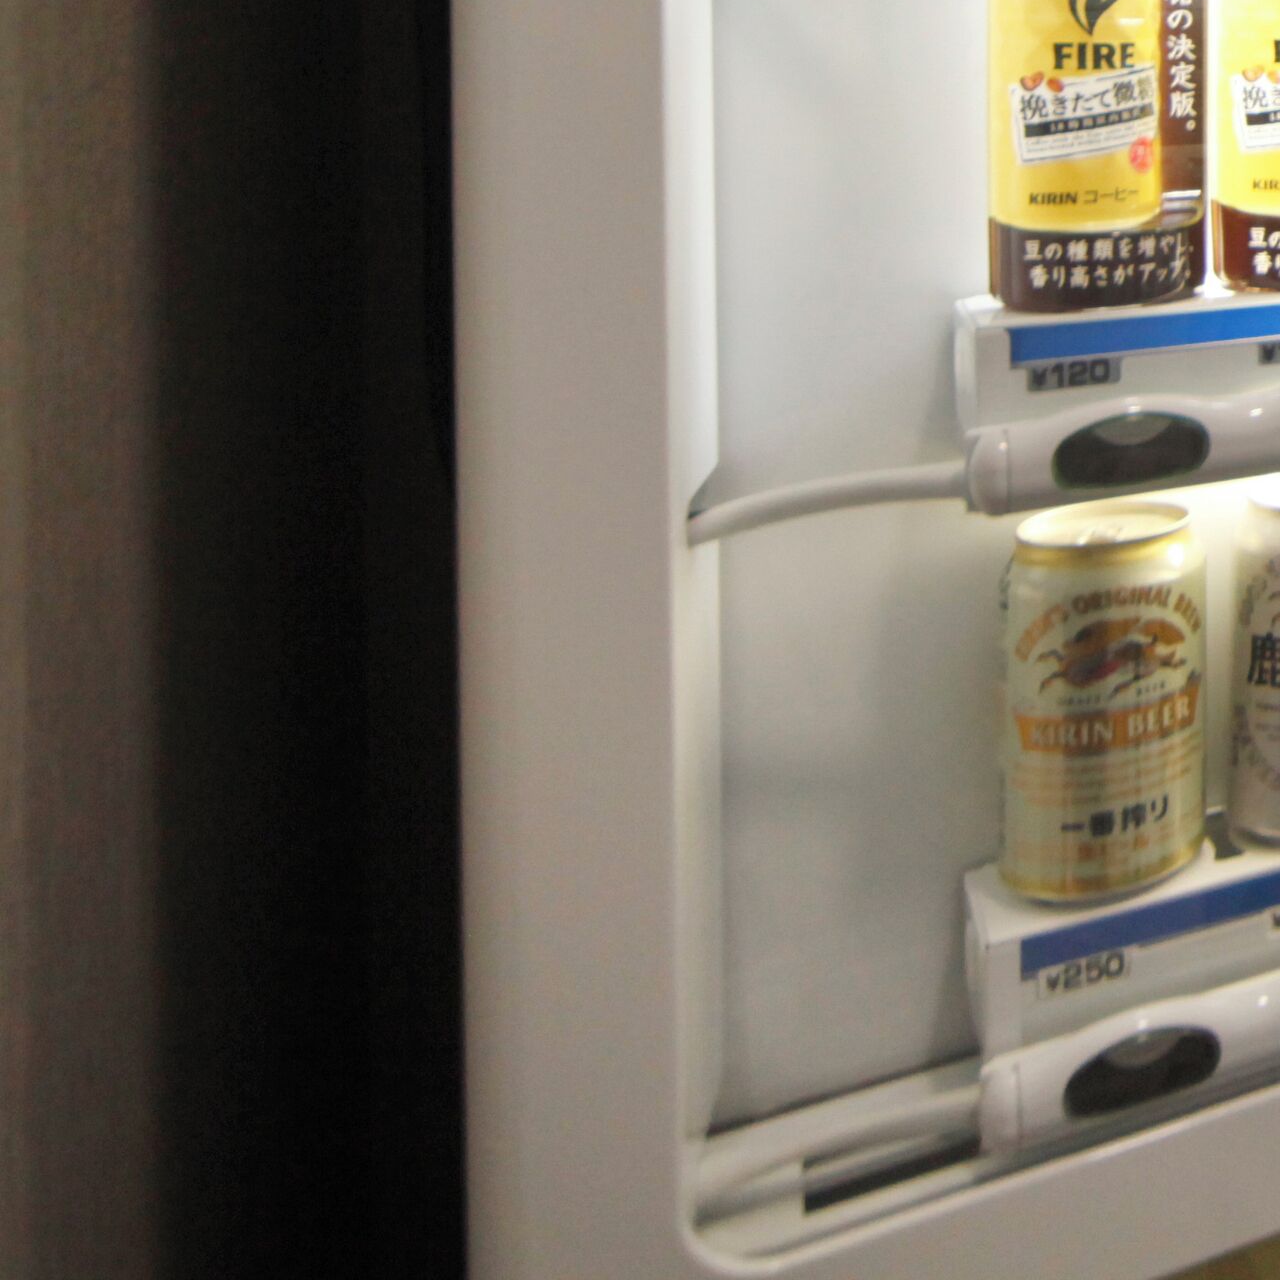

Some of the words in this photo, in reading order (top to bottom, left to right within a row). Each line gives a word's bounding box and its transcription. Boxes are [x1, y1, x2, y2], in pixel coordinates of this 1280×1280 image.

[1053, 42, 1135, 70] FIRE
[1029, 192, 1078, 206] KIRIN
[1030, 358, 1110, 388] ¥120
[1128, 695, 1190, 737] BEER
[1061, 794, 1169, 837] 一番搾り
[1046, 953, 1125, 992] ¥250
